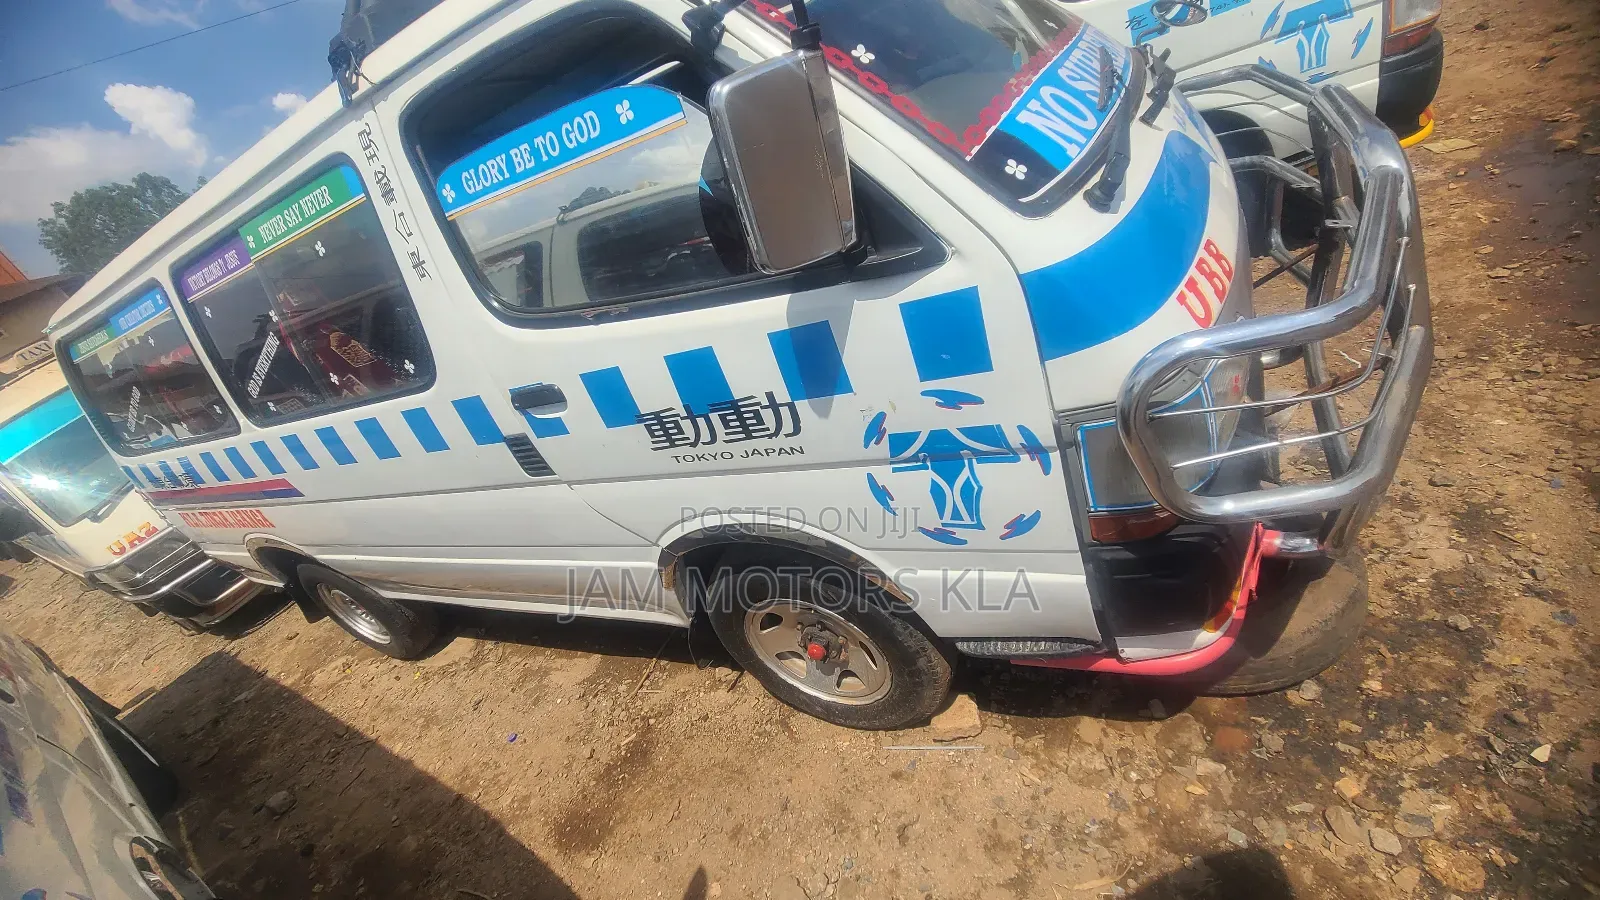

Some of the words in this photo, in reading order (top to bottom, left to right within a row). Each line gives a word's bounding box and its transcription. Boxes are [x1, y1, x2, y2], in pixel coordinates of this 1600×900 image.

[1015, 85, 1098, 159] NO
[461, 155, 511, 195] GLORY
[512, 145, 534, 174] BE
[534, 130, 560, 163] TO
[561, 109, 601, 150] GOD
[257, 213, 288, 244] NEVER
[283, 202, 303, 228] SAY
[299, 184, 334, 218] NEVER
[1175, 236, 1234, 330] UBB
[16, 341, 53, 362] TAXI
[254, 331, 280, 380] EVERYTHING
[247, 379, 260, 399] GOD
[252, 371, 263, 387] IS
[634, 390, 802, 452] 動動
[670, 451, 734, 464] TOKYO
[739, 445, 806, 461] JAPAN
